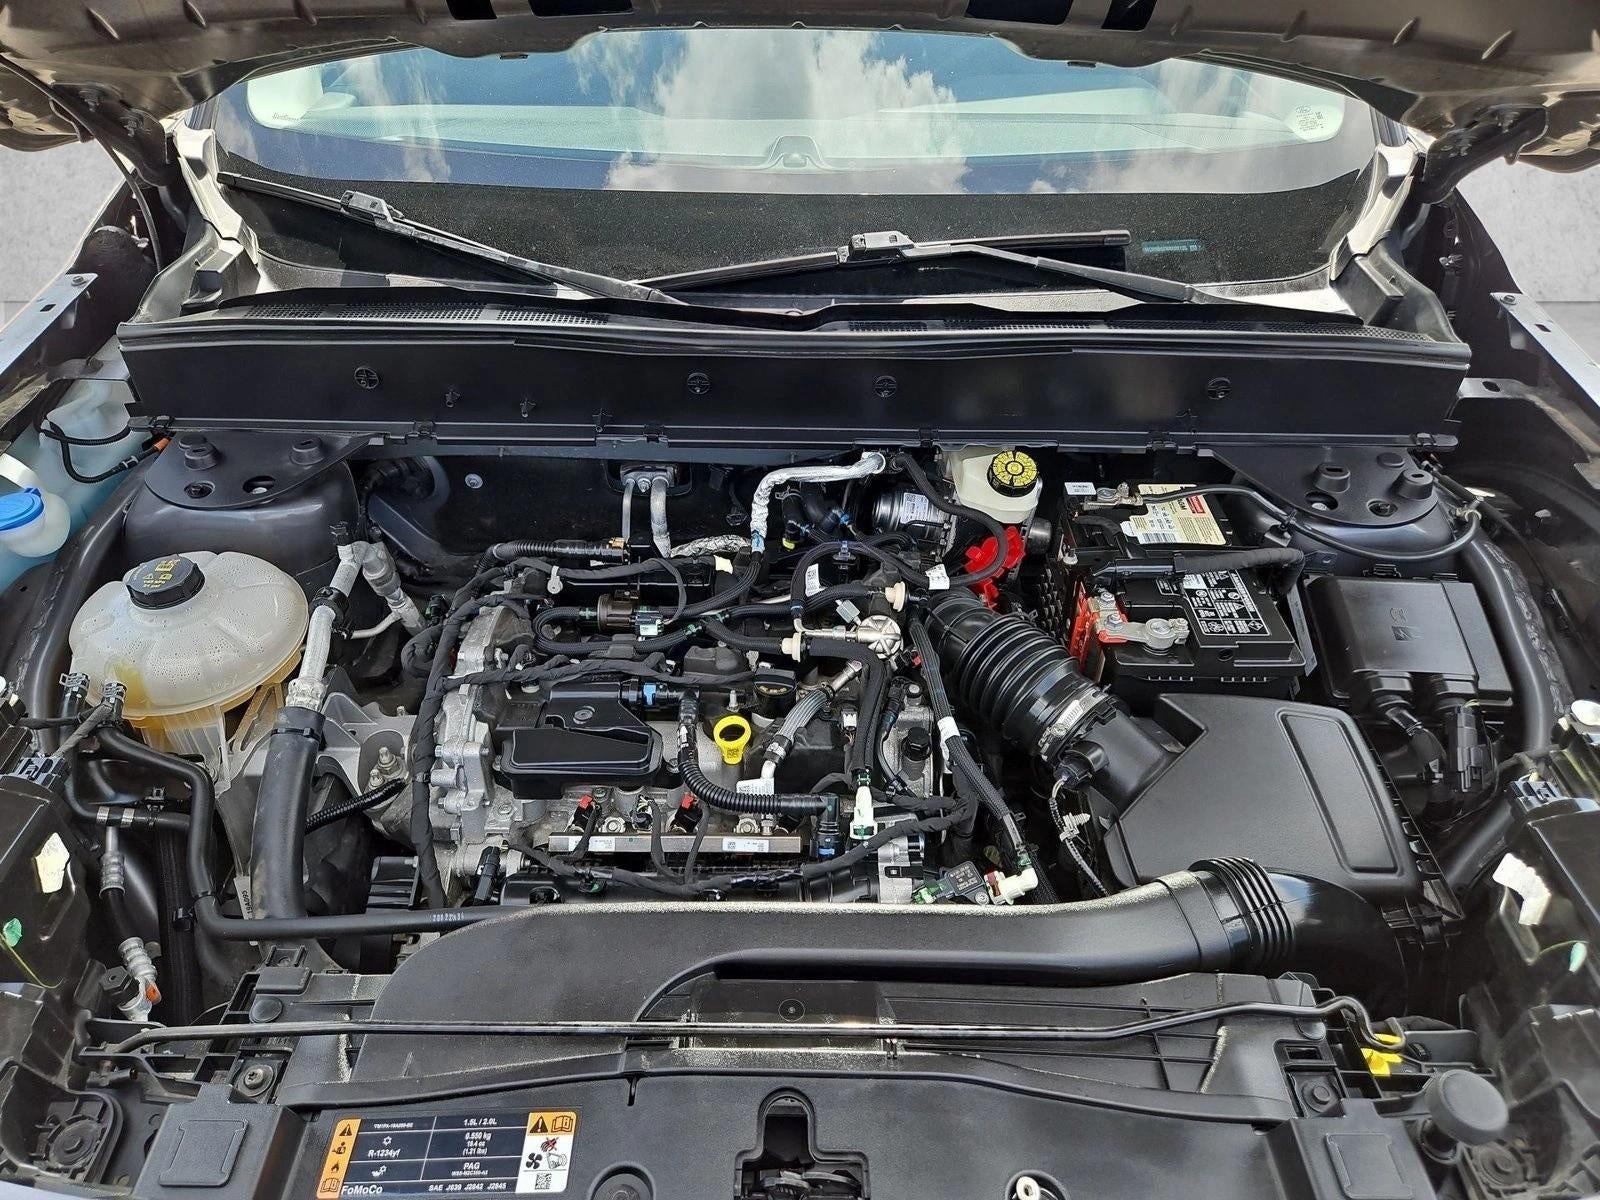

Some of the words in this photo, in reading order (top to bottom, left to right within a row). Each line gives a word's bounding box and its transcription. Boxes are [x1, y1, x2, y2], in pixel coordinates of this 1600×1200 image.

[482, 1117, 497, 1126] 2.0L
[483, 1132, 492, 1141] kg
[367, 1148, 401, 1158] R-1234yf
[463, 1162, 480, 1170] PAG
[341, 1184, 383, 1195] FoMoCo
[428, 1184, 443, 1192] SAE
